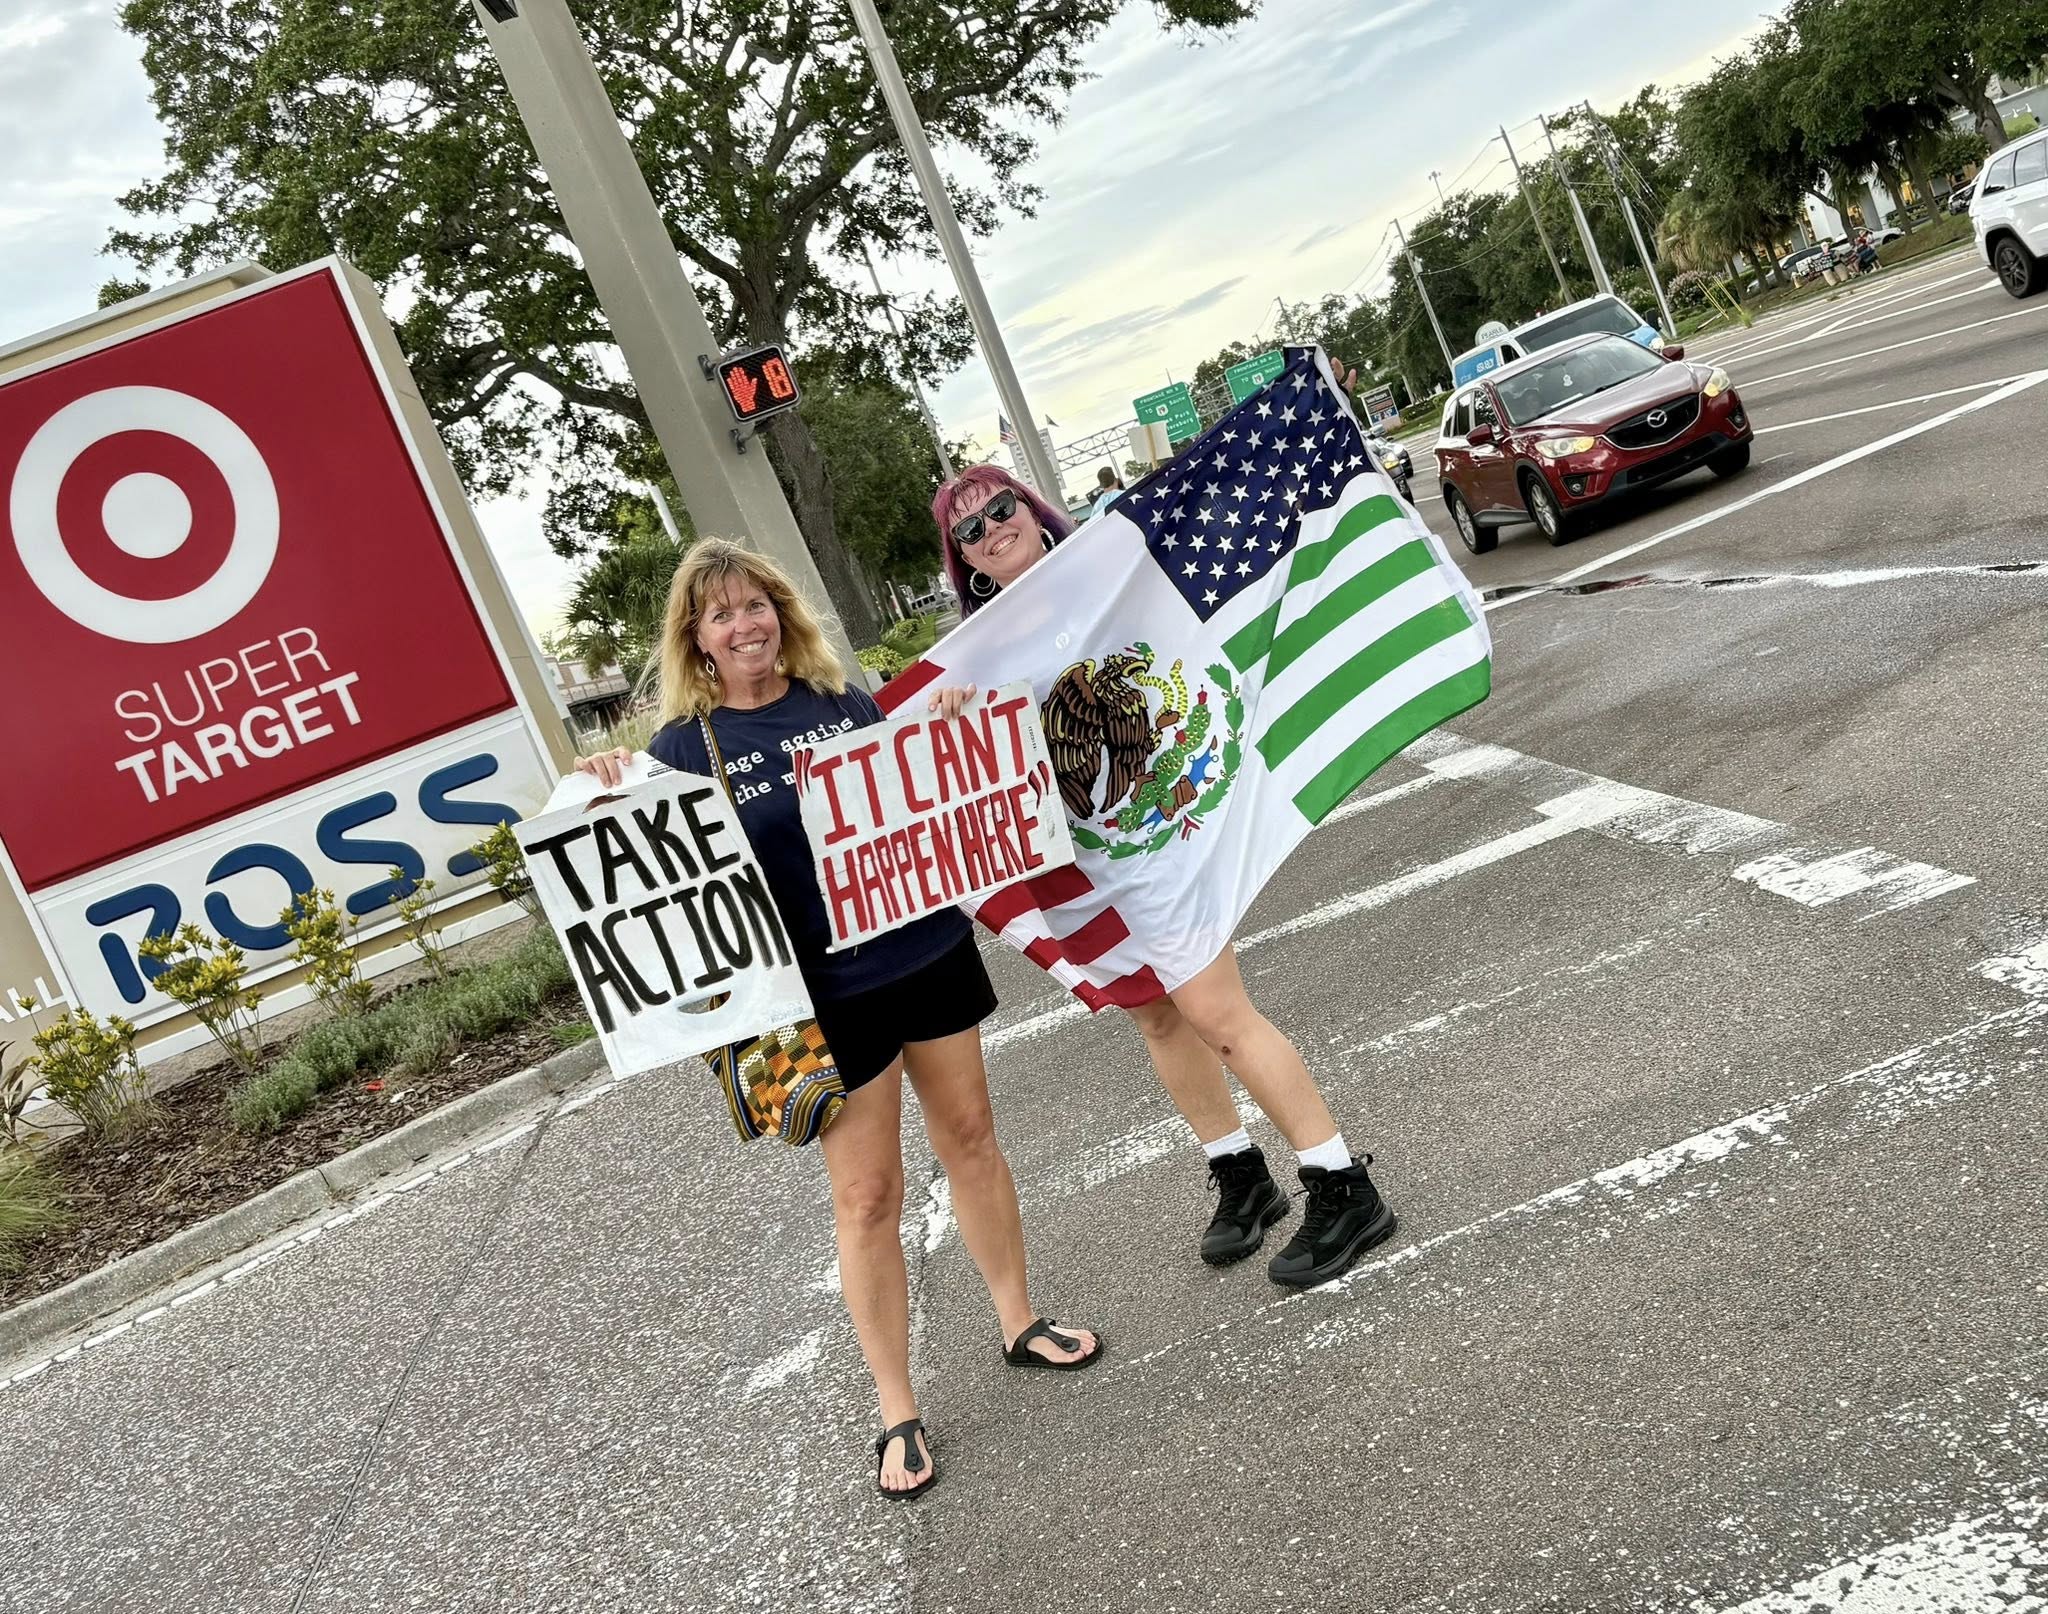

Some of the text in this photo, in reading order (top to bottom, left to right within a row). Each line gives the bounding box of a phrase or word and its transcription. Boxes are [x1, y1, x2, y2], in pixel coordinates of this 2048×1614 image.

[1174, 410, 1190, 419] Park
[115, 627, 331, 742] SUPER
[115, 671, 361, 803] TARGET
[724, 751, 765, 777] age
[780, 717, 854, 753] agains
[735, 781, 773, 804] the
[893, 690, 1029, 814] CAN'T
[85, 753, 524, 1004] ROSS
[524, 787, 741, 912] TAKE
[823, 811, 965, 940] HAPPEN
[565, 863, 792, 1034] ACTION
